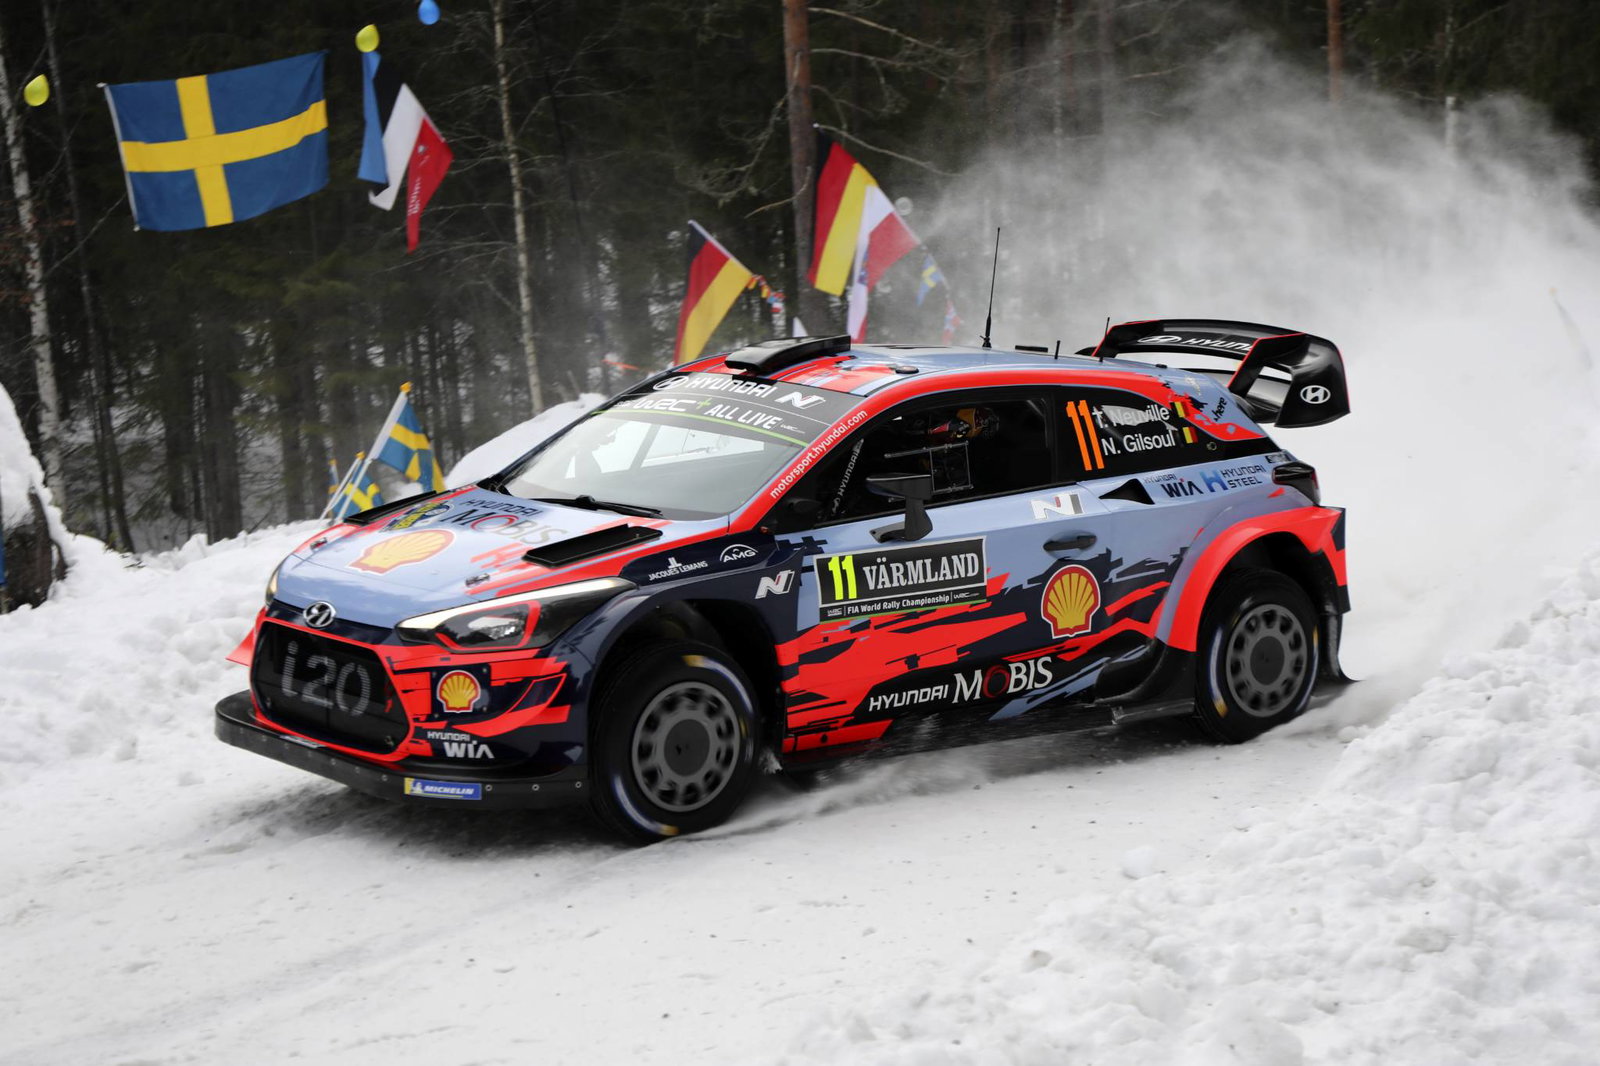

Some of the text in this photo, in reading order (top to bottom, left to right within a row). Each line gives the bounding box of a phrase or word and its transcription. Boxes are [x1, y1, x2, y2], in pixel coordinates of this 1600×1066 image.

[1181, 338, 1253, 351] HYUN
[686, 377, 778, 398] HYUNDAI
[704, 403, 735, 420] ALL
[737, 409, 783, 429] LIVE
[1109, 404, 1170, 427] Neuville
[1066, 400, 1105, 471] 11
[1101, 430, 1176, 455] N. Gilsoul
[770, 410, 868, 498] motorsport.hyundai.com
[838, 452, 859, 496] HYUNDAI
[1143, 473, 1178, 484] HYUNDAI
[1220, 465, 1268, 479] HYUNDAI
[1228, 476, 1264, 488] STEEL
[460, 499, 543, 516] HYUNDAI
[440, 508, 568, 544] MOBIS
[723, 549, 756, 563] AMG
[648, 560, 708, 581] JACQUES LEMANS
[827, 553, 980, 600] 11 VÄRMLAND
[847, 604, 859, 615] FIA
[860, 602, 881, 612] World
[882, 600, 901, 611] Rally
[901, 595, 950, 609] Championship
[281, 641, 372, 718] i20
[868, 656, 1054, 712] HYUNDAI MOBIS
[427, 731, 470, 741] HYUNDAI
[424, 785, 475, 795] MICHELIN
